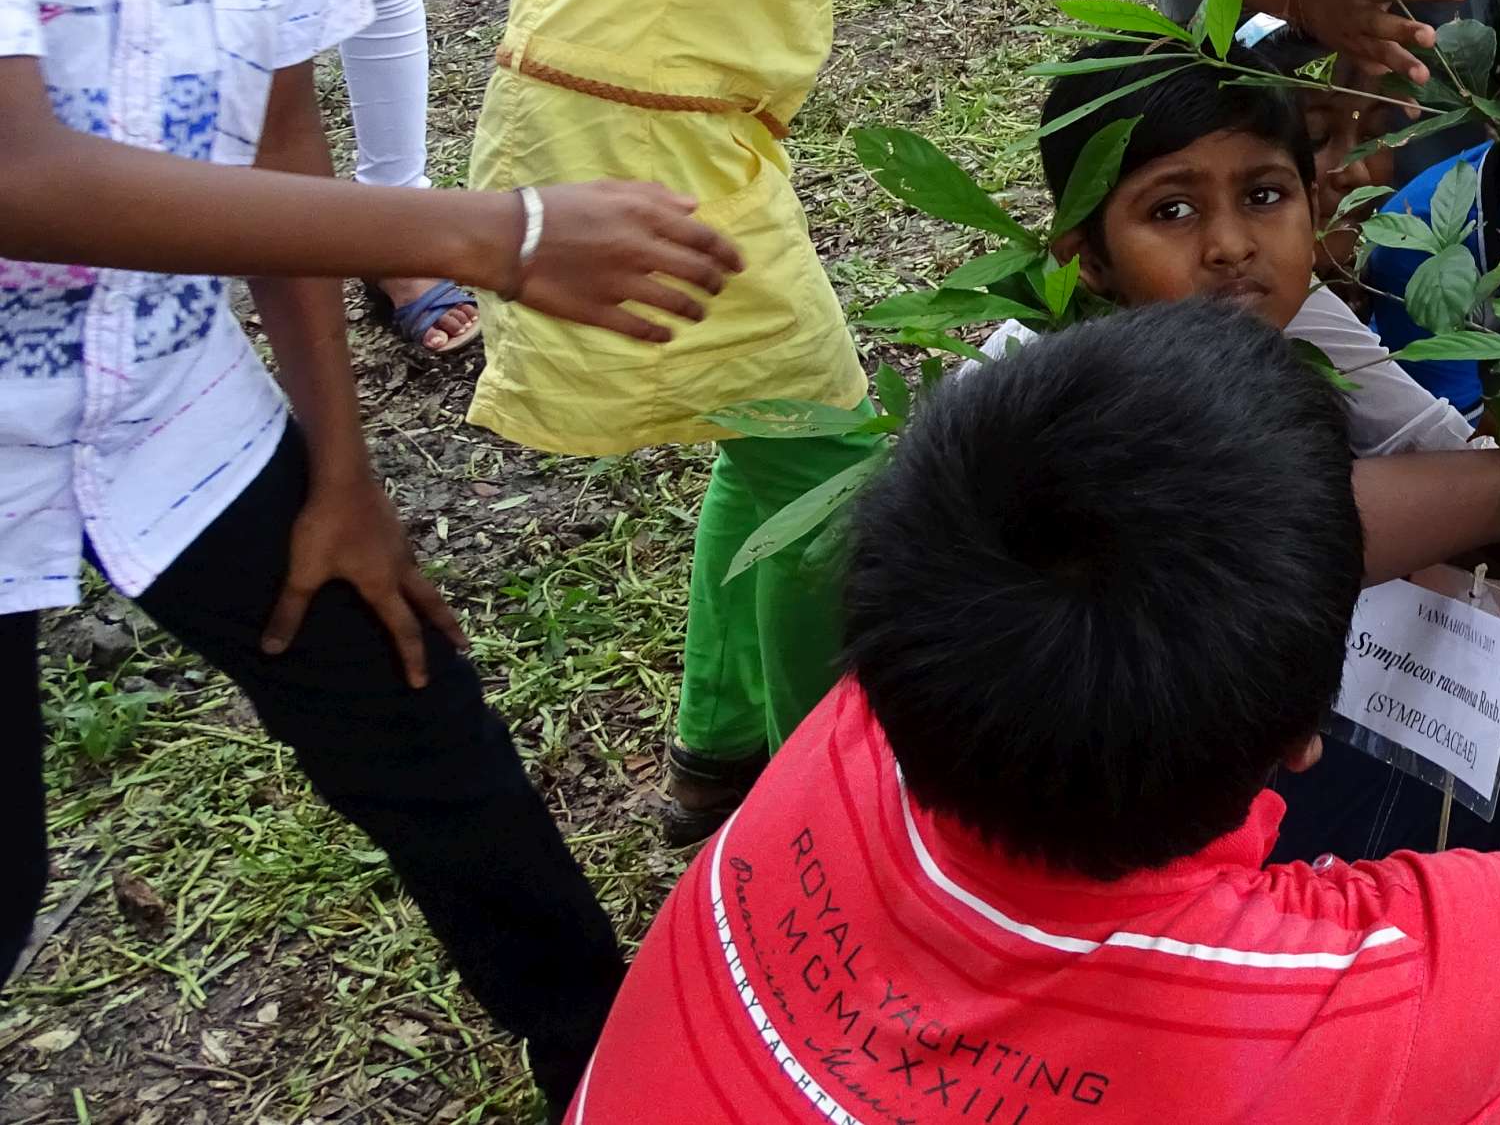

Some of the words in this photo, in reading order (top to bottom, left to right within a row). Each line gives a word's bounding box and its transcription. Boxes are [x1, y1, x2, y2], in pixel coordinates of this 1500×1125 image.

[1352, 631, 1437, 684] Symplocos
[1436, 674, 1479, 707] racemosa
[1478, 690, 1500, 724] Roxb.
[1364, 691, 1478, 769] (SYMPLOCACEAE)
[711, 897, 760, 1013] LUXURY
[789, 827, 866, 981] ROYAL
[878, 979, 1110, 1105] YACHTING
